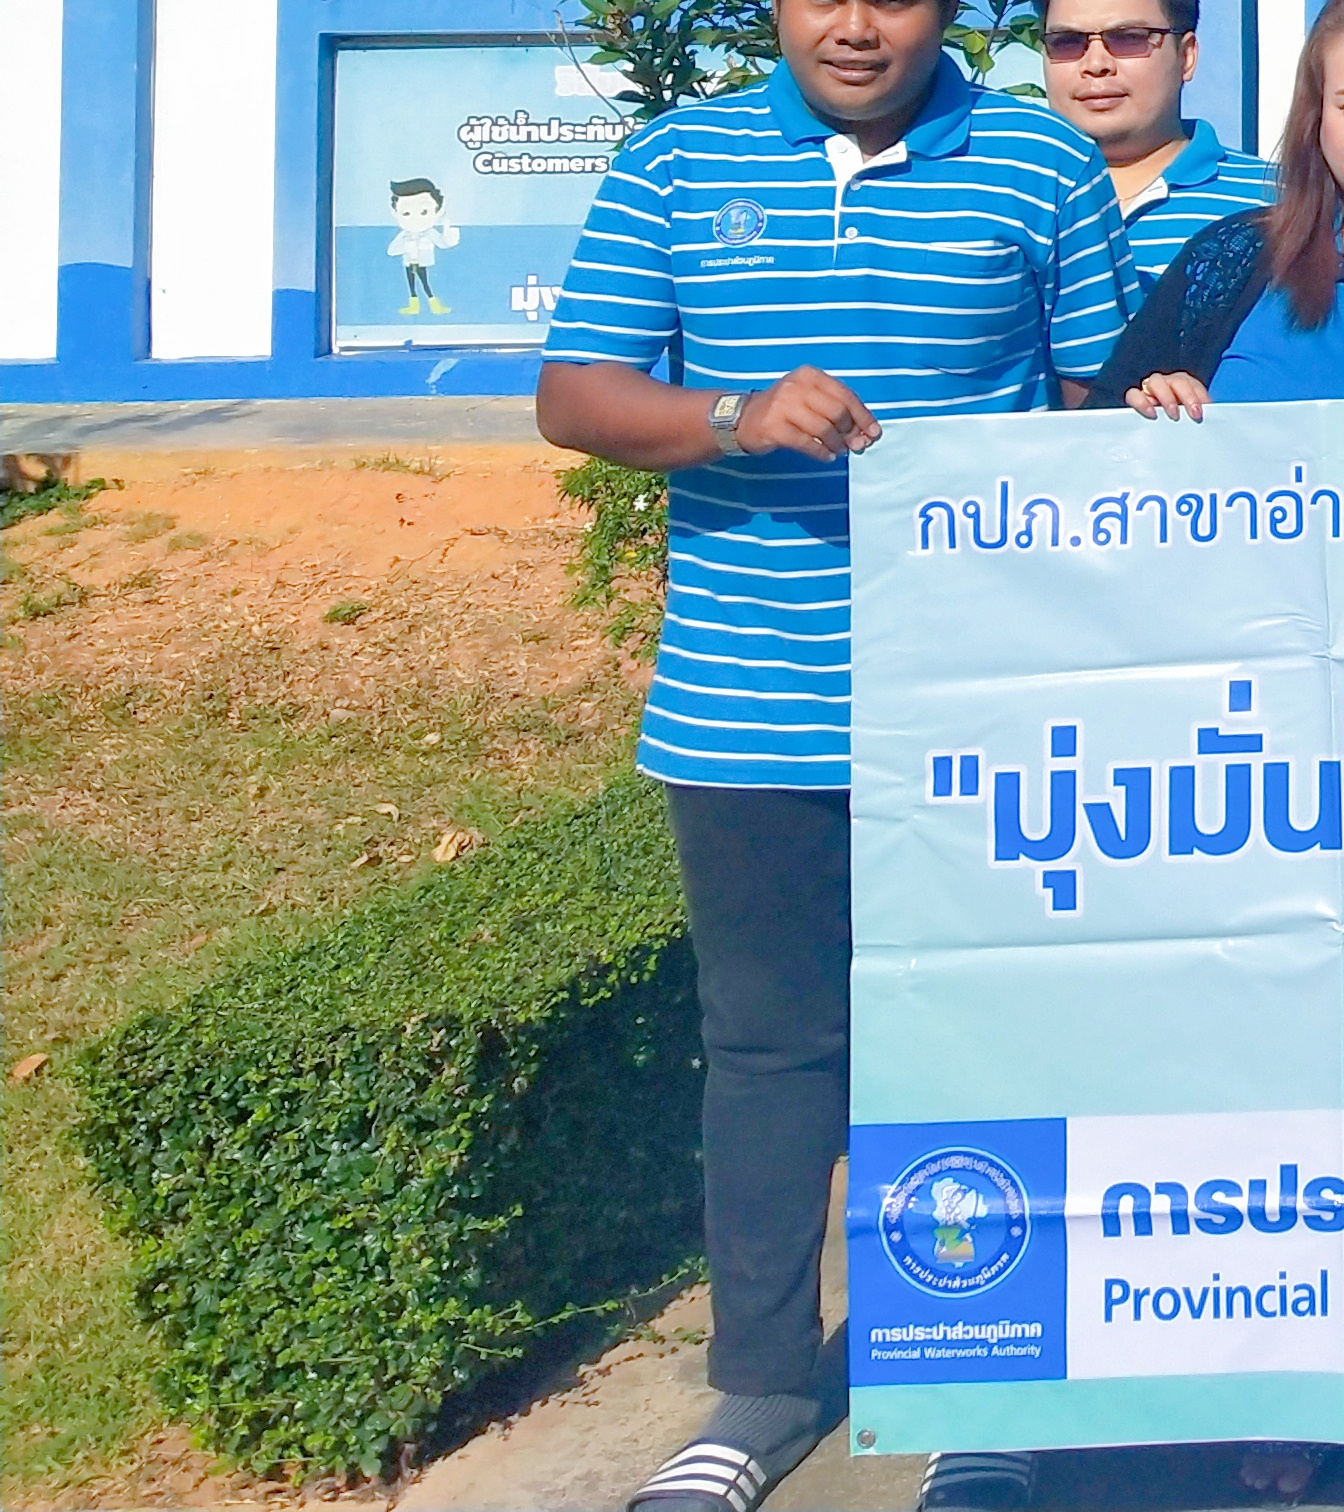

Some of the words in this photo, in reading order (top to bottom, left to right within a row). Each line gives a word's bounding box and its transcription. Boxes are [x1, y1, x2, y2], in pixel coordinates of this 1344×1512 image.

[474, 152, 610, 175] Customers
[1104, 1270, 1330, 1323] Provincial
[870, 1320, 1042, 1344] การประปาส่วนภูมิภาค
[870, 1347, 921, 1360] Provincial
[924, 1346, 988, 1358] Waterworks
[991, 1343, 1042, 1358] Authority
